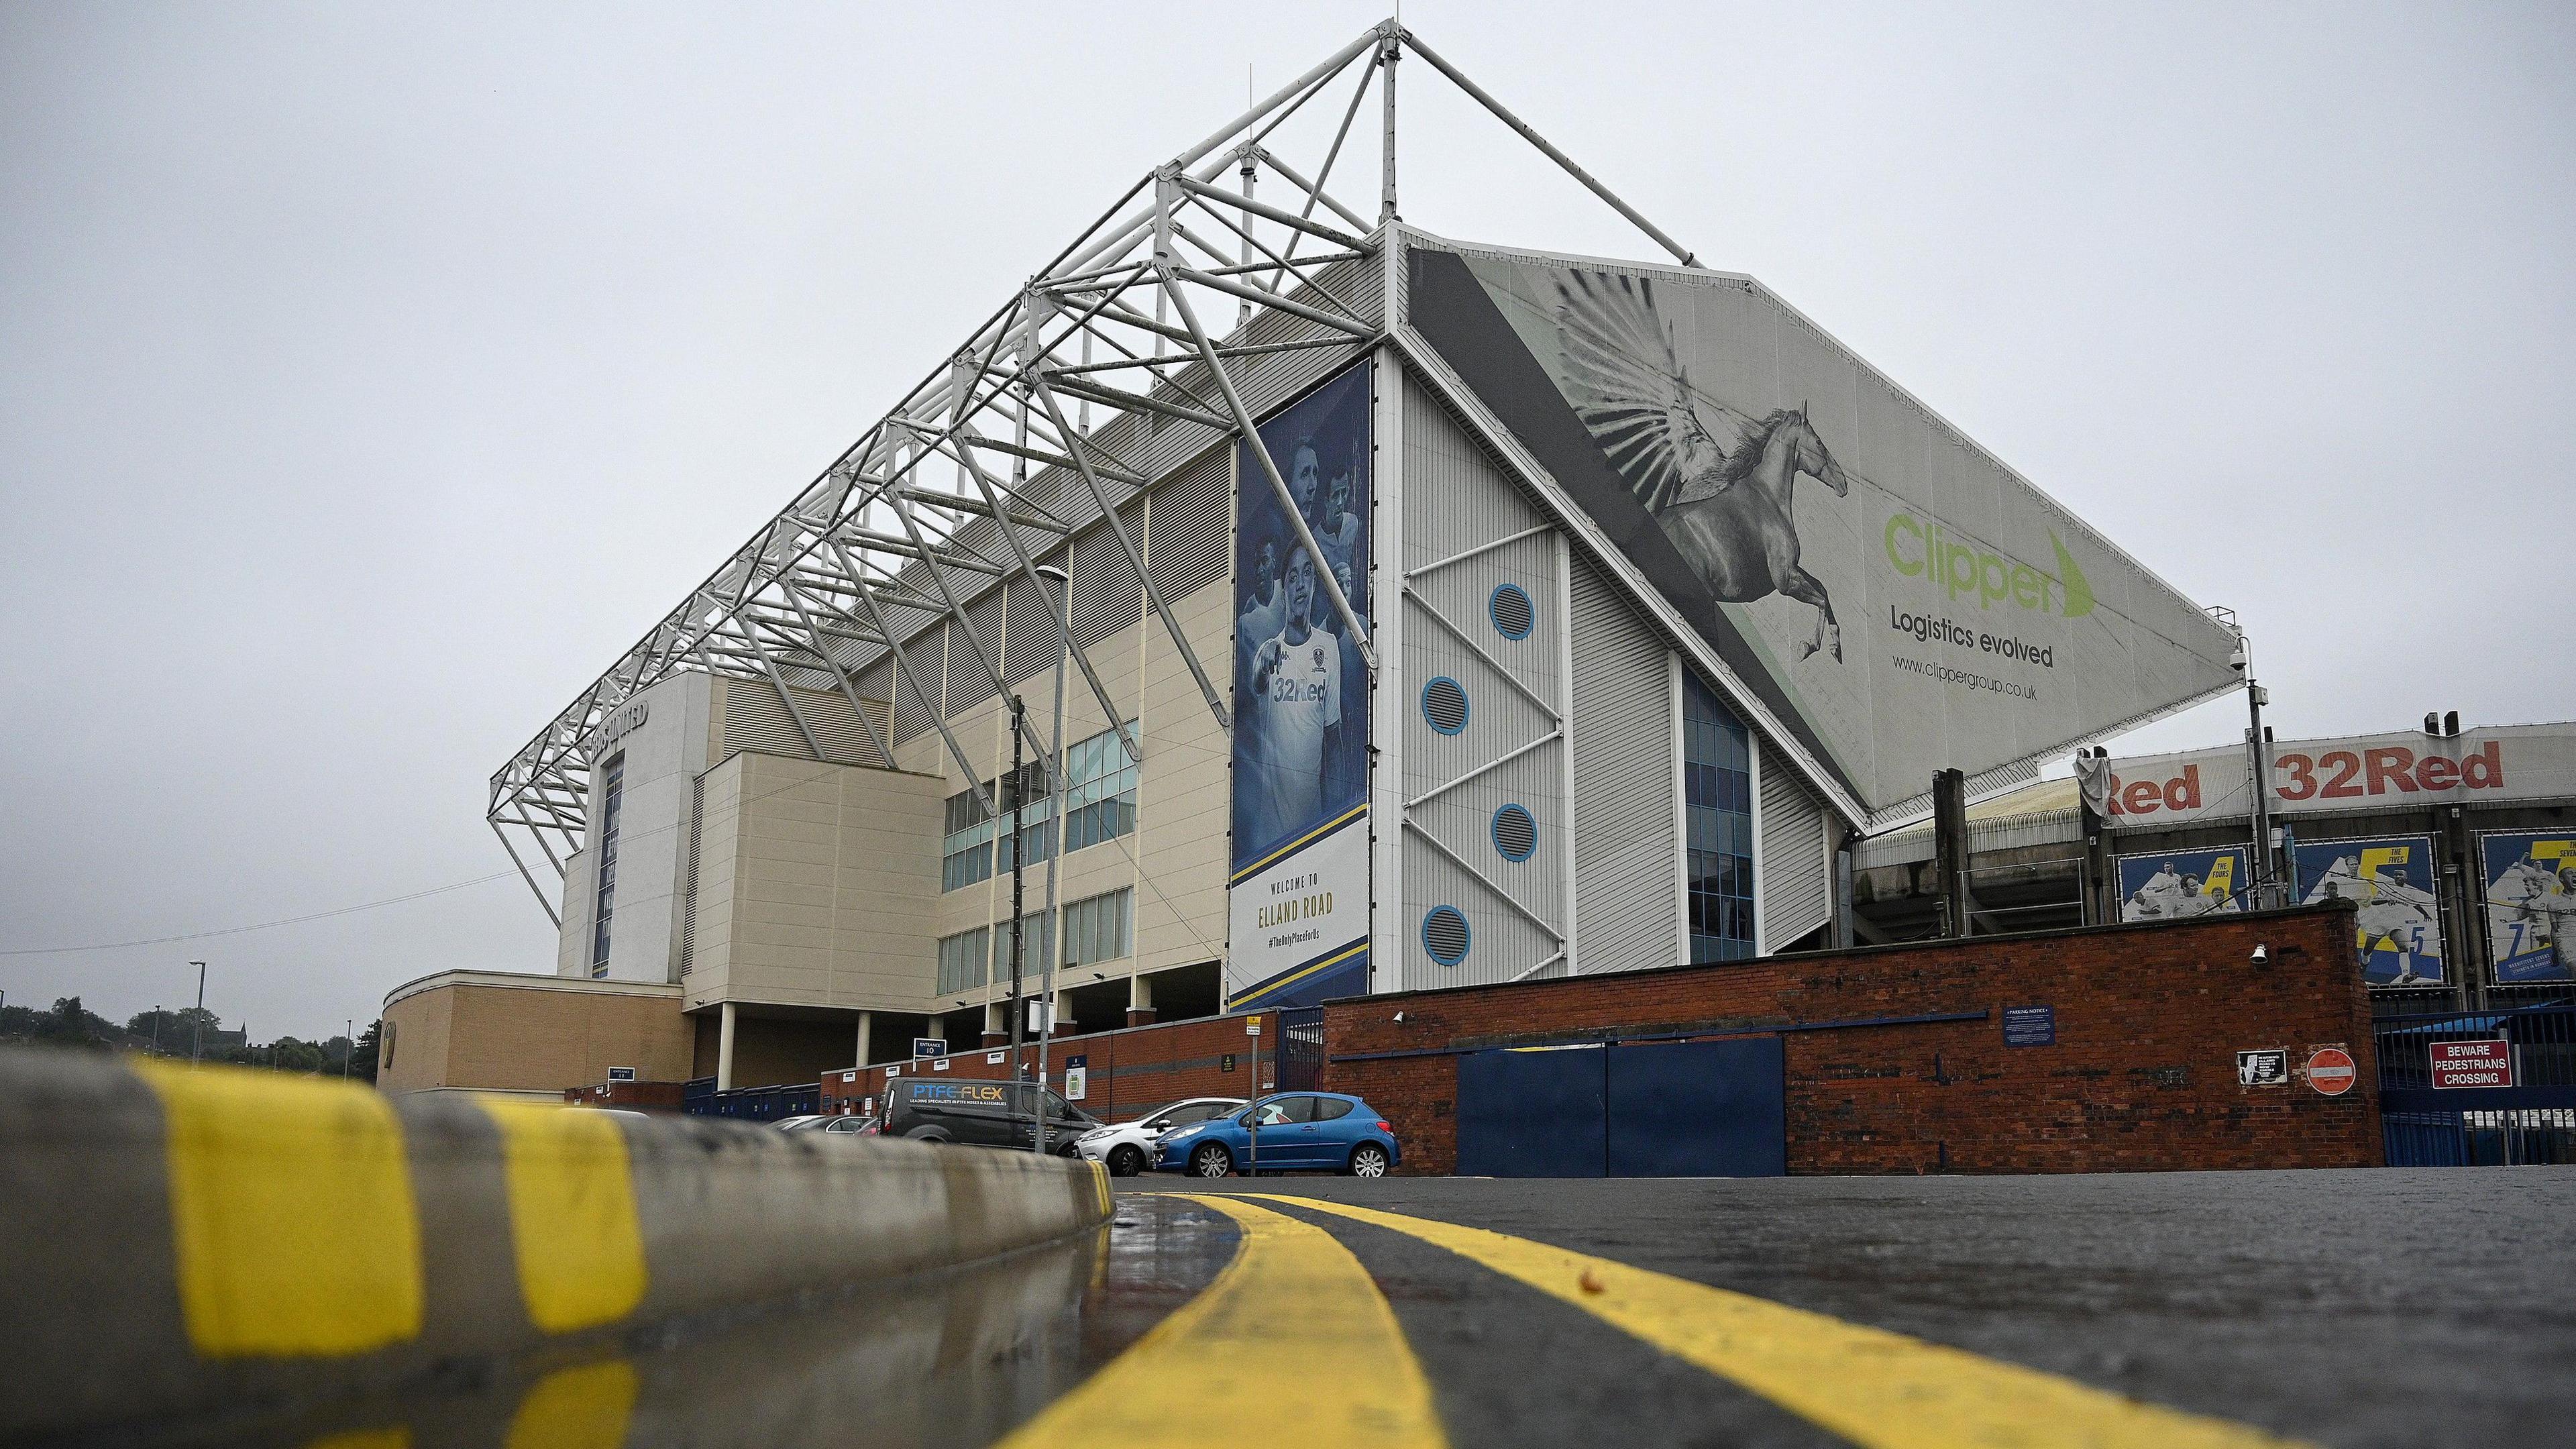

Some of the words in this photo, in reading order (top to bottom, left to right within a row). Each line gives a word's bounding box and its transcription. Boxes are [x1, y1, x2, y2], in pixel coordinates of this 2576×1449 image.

[1884, 514, 2055, 613] Clipper
[1891, 604, 1974, 648] Logistics
[1980, 633, 2053, 668] evolved
[1274, 677, 1326, 702] 32Red
[1892, 655, 2038, 701] www.clippergroup.co.uk
[2274, 741, 2504, 801] 32Red
[2216, 862, 2227, 870] THE
[2388, 855, 2404, 863] FIVES
[1271, 875, 1305, 896] WELCOME
[1309, 873, 1318, 886] TO
[2212, 869, 2229, 878] FOURS
[1258, 900, 1298, 928] ELLAND
[1303, 892, 1332, 919] ROAD
[1269, 928, 1320, 948] #TheOnlyPlaceForUs
[2409, 926, 2425, 955] 5
[2509, 924, 2524, 959] 7
[2447, 1045, 2490, 1057] BEWARE
[2435, 1058, 2506, 1071] PEDESTRIANS
[2445, 1073, 2499, 1085] CROSSING
